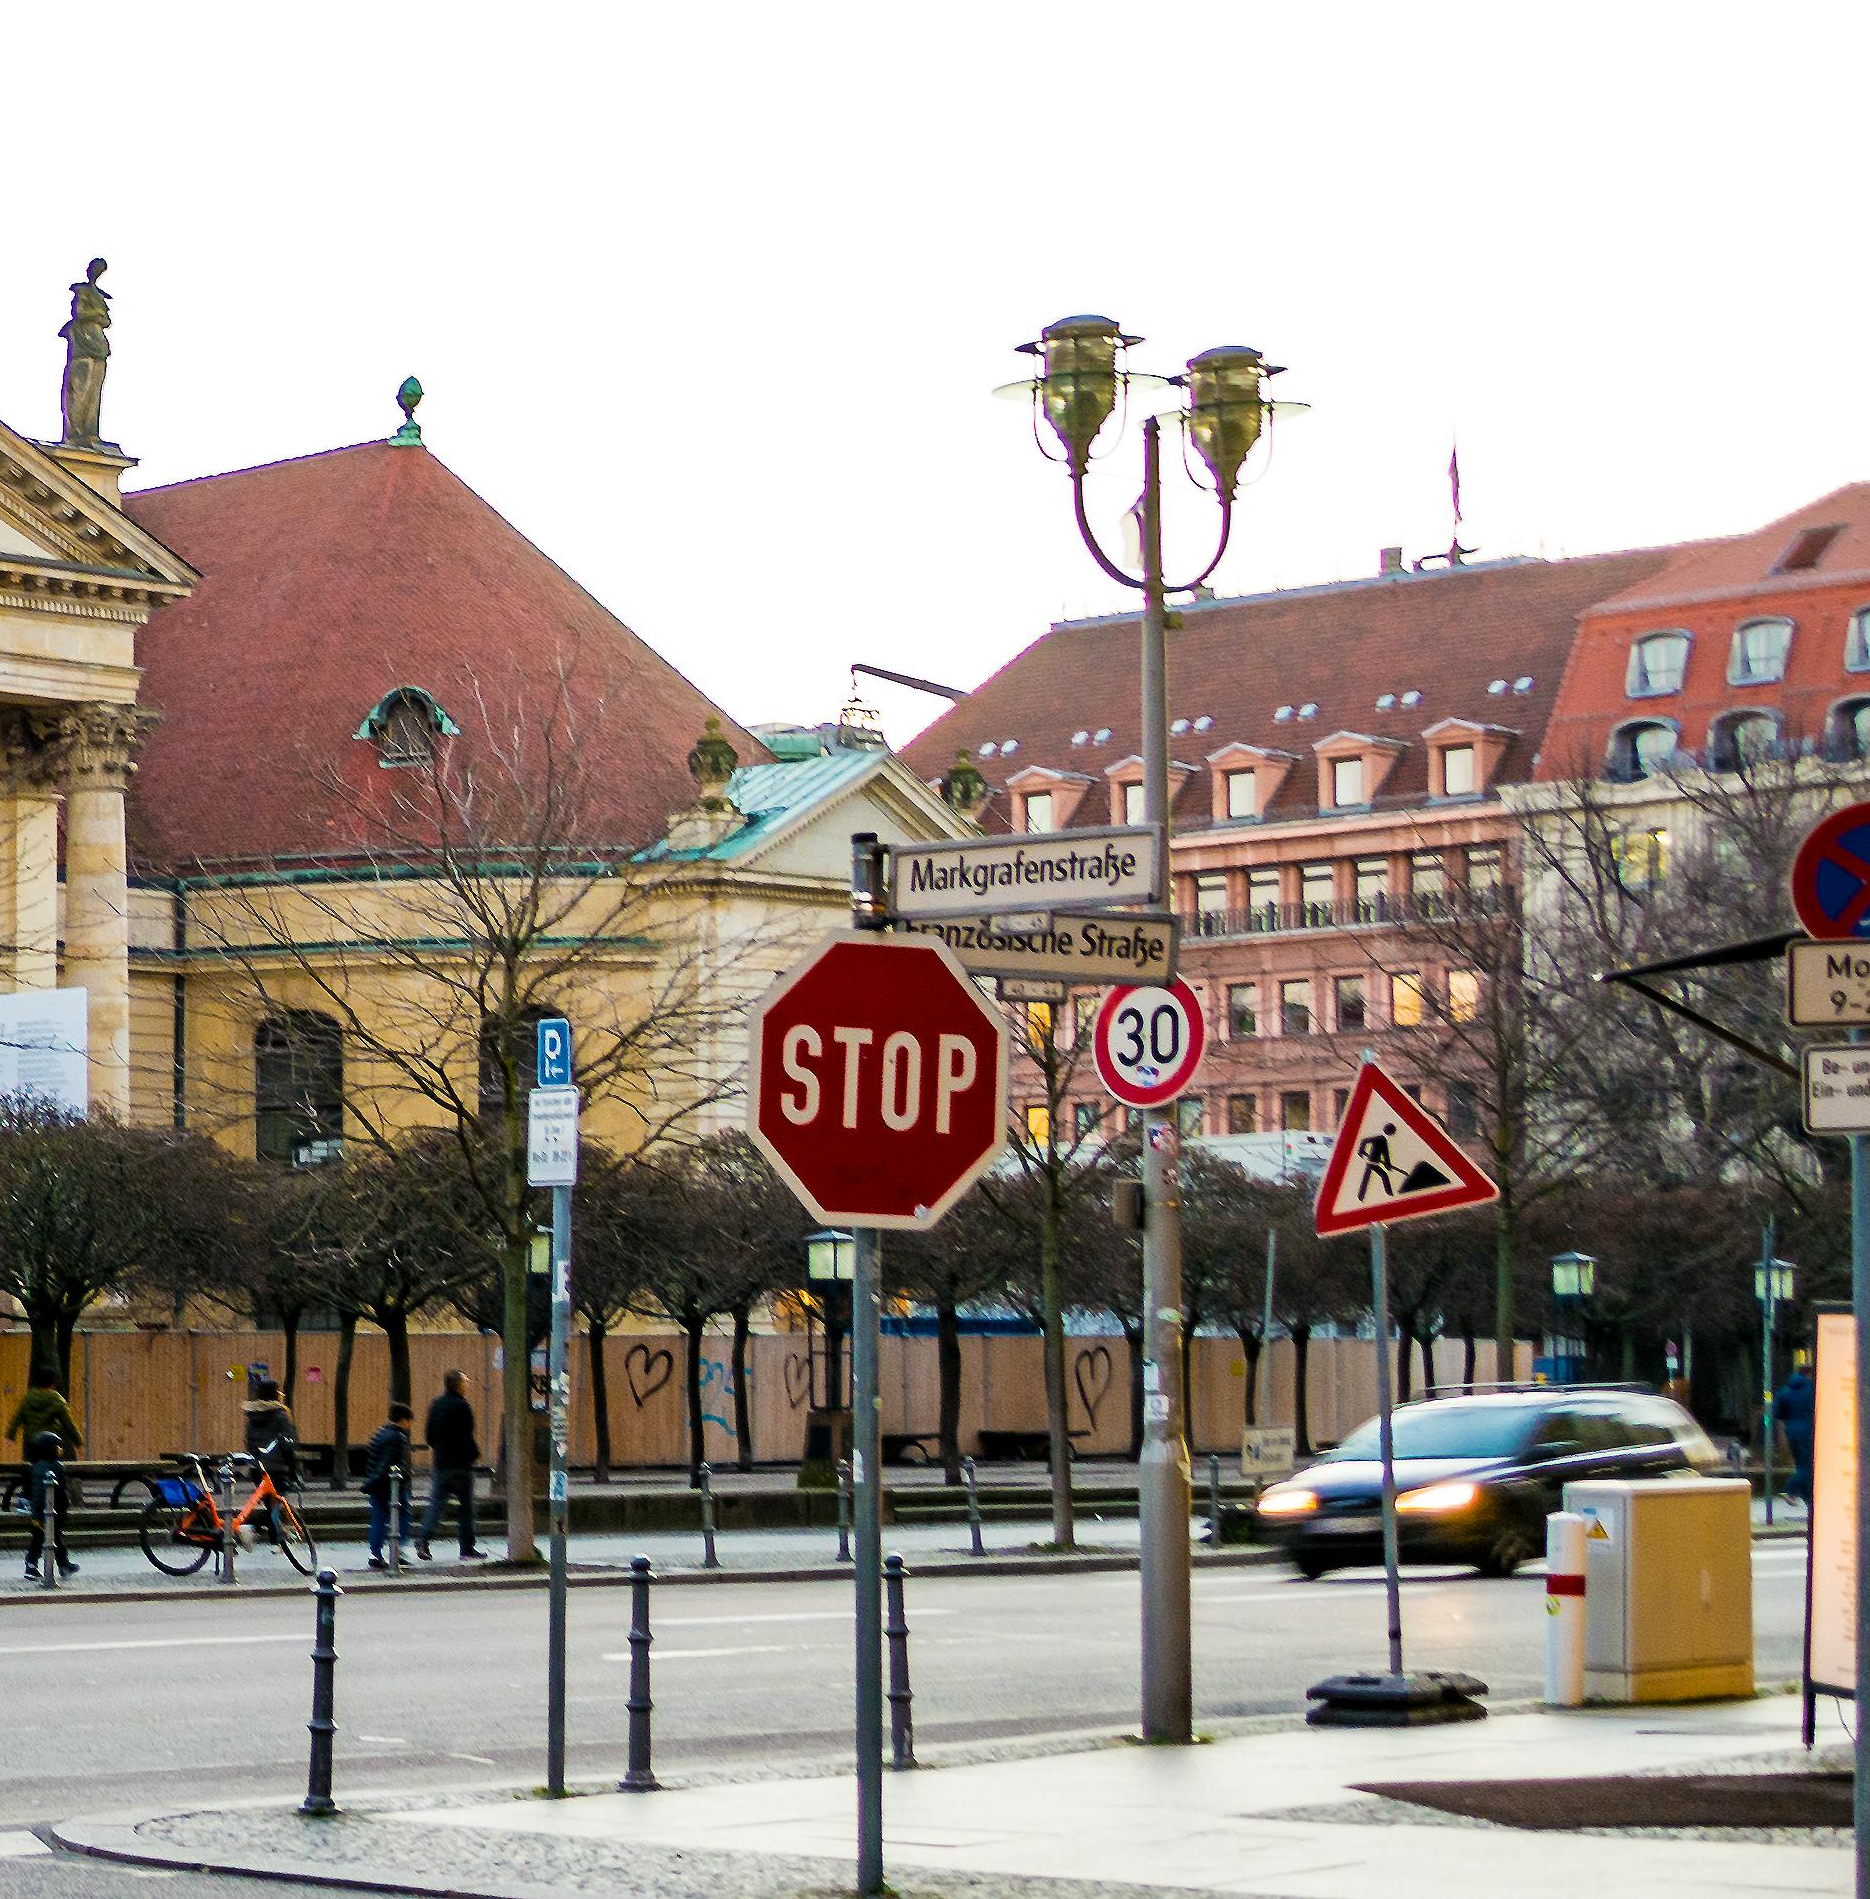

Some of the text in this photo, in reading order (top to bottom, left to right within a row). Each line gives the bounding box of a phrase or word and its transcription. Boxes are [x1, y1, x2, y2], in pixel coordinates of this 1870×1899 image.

[910, 843, 1136, 896] Markgrafenstraße
[1079, 923, 1164, 968] Straße
[1117, 1004, 1180, 1068] 30
[780, 1023, 978, 1135] STOP
